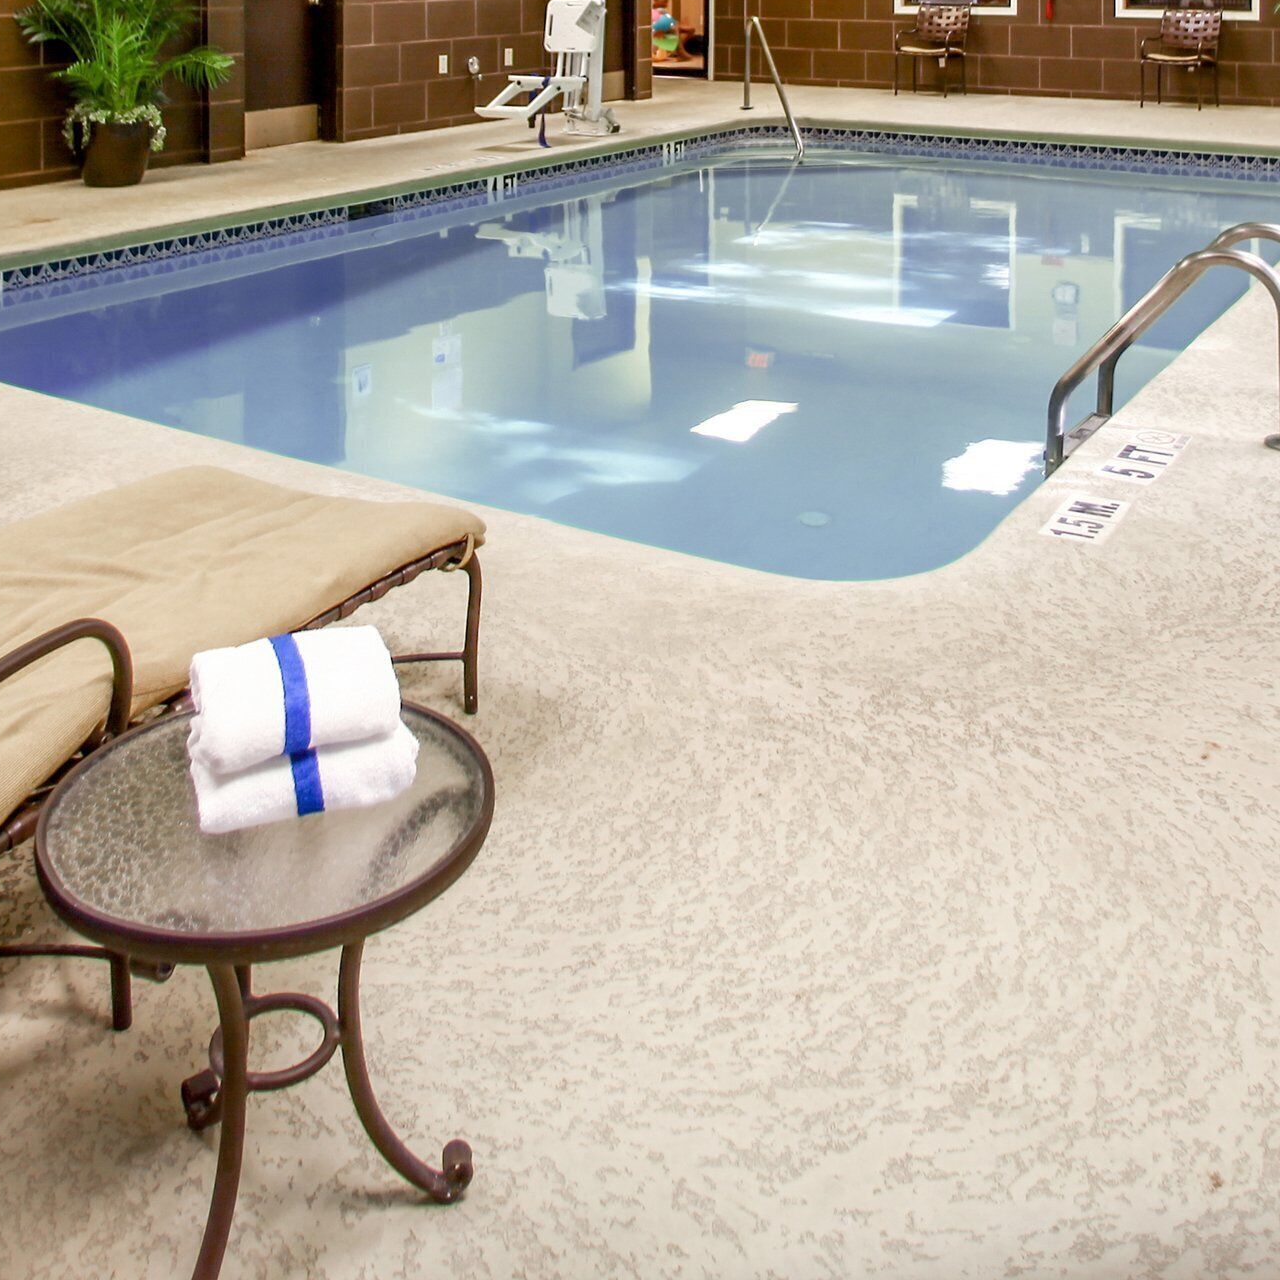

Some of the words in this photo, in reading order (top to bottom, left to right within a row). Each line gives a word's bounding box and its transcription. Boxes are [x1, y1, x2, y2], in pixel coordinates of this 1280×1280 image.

[674, 140, 683, 153] FT
[503, 173, 516, 189] FT
[1117, 444, 1174, 466] FT
[1101, 464, 1155, 480] 5
[1050, 517, 1104, 539] 1.5
